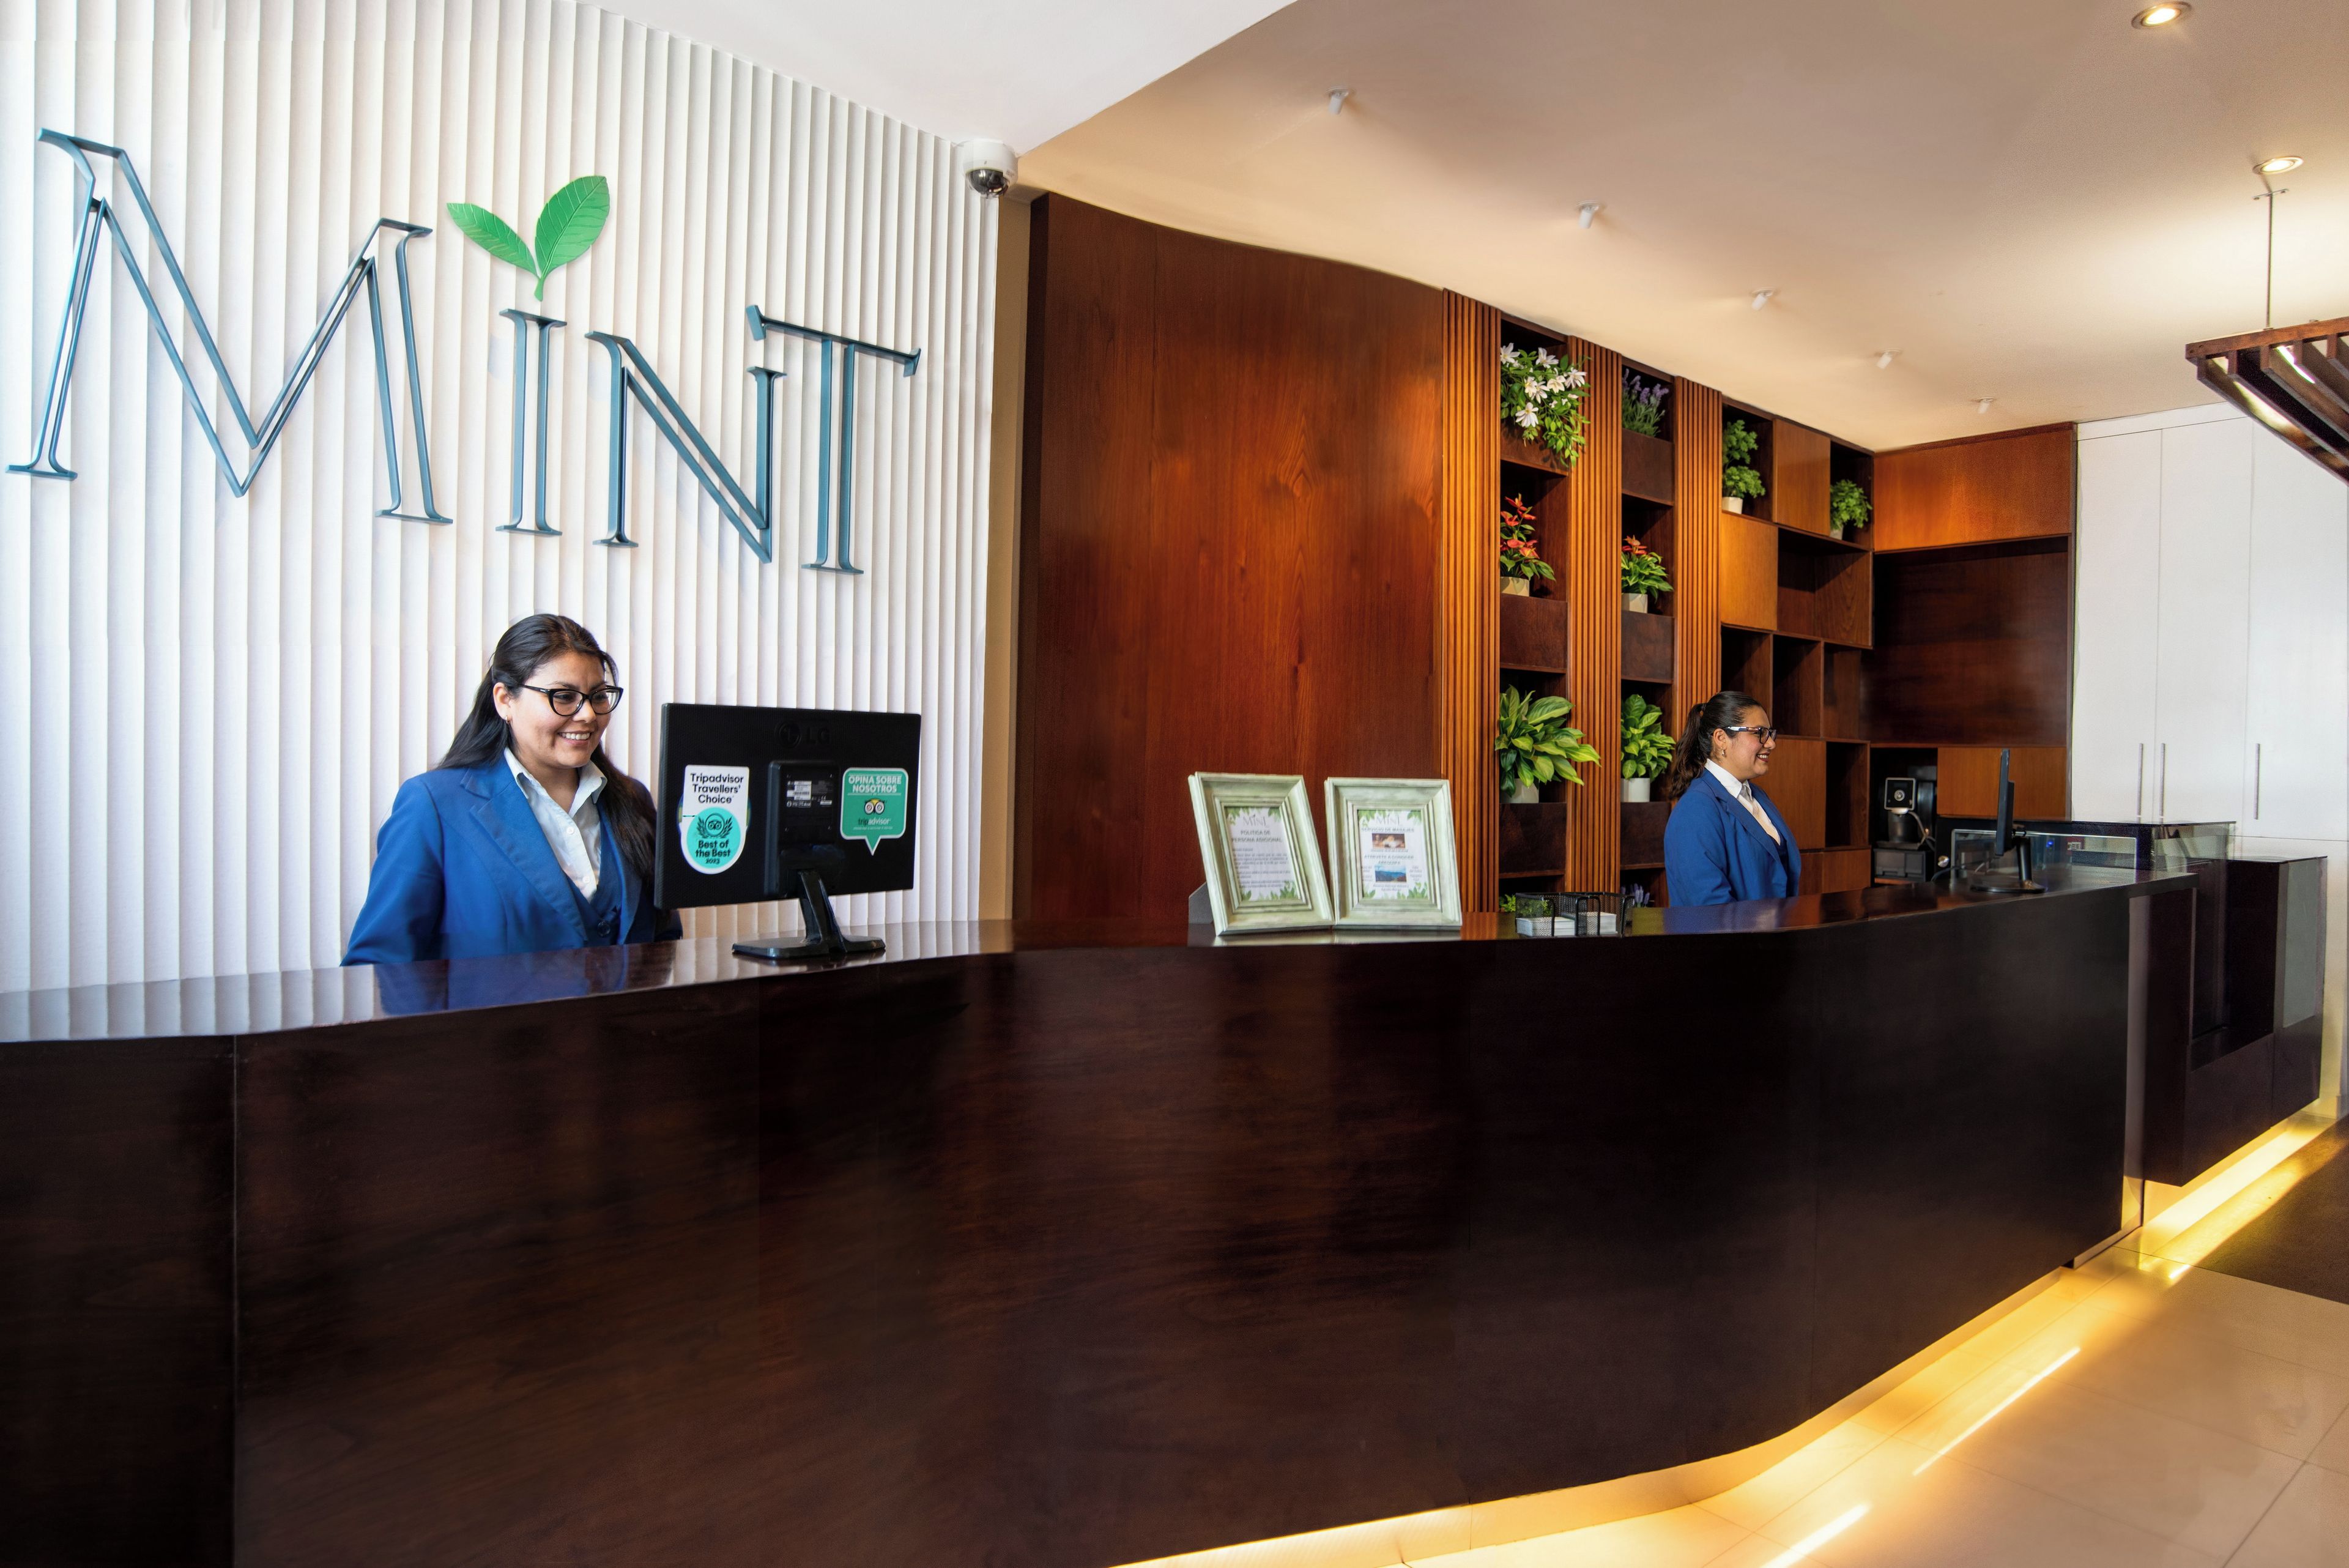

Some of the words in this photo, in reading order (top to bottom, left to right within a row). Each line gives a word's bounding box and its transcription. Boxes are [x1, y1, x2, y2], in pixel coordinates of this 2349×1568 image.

[690, 773, 744, 784] Tripadvisor
[848, 776, 875, 784] OPINA
[875, 776, 902, 784] SOBRE
[852, 784, 897, 793] NOSOTROS
[698, 794, 732, 804] Choice
[858, 817, 890, 826] tripadvisor
[698, 840, 718, 849] Best
[719, 839, 730, 849] of
[696, 848, 710, 857] the
[711, 848, 730, 857] Best
